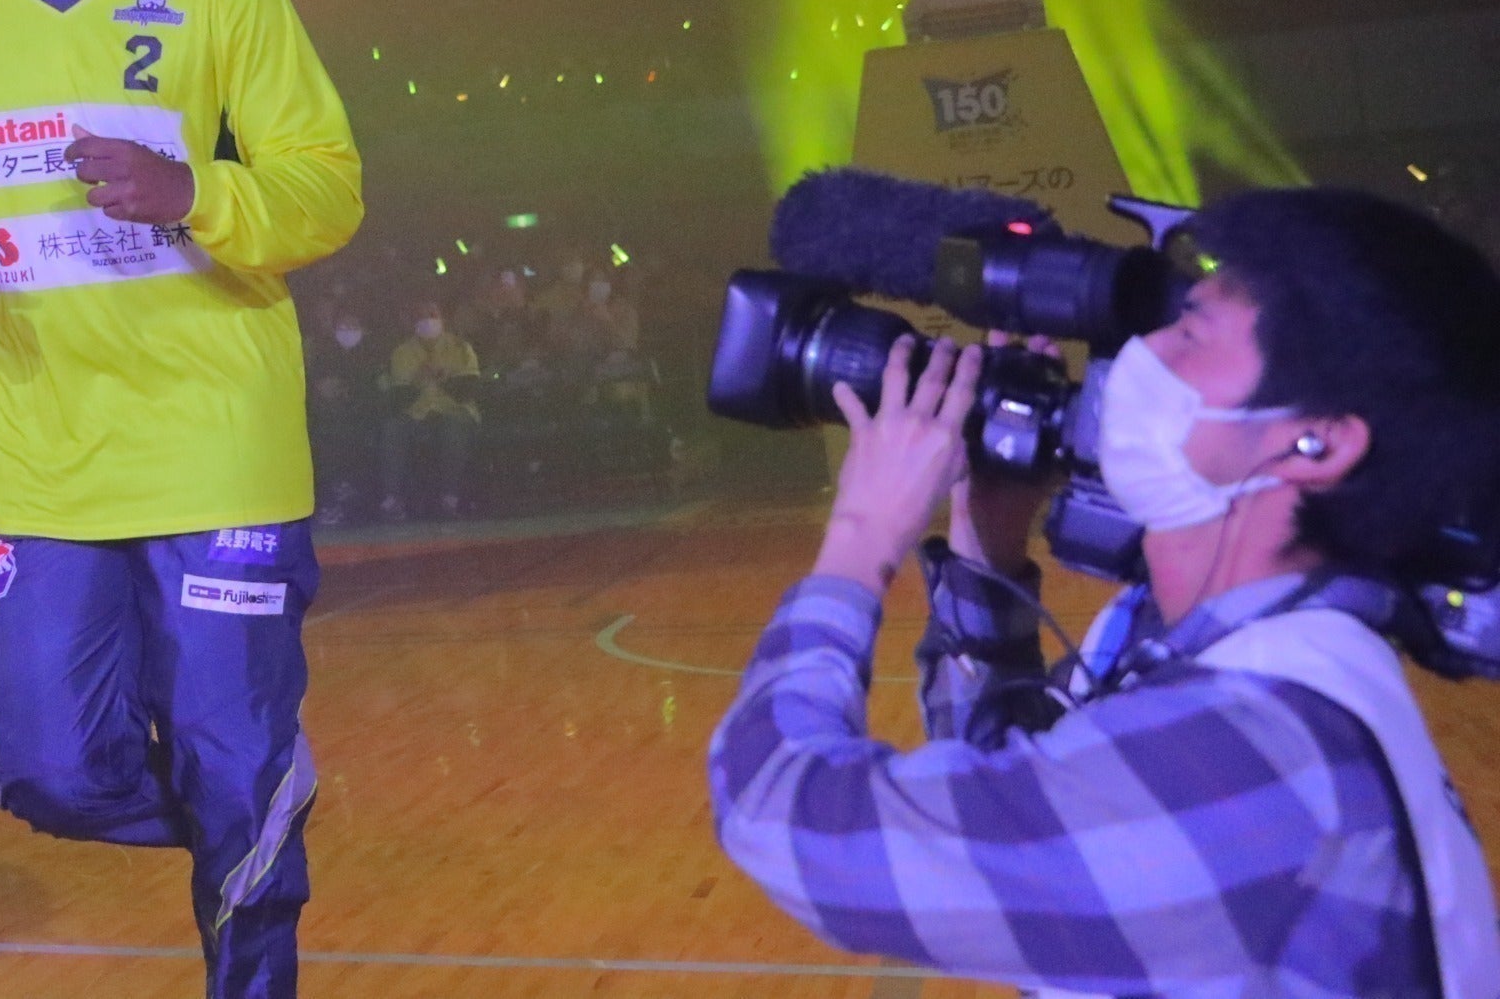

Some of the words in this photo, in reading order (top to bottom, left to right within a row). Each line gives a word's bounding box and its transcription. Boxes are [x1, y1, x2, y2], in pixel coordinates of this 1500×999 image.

[124, 34, 162, 93] 2
[936, 83, 1006, 123] 150
[38, 225, 143, 260] 株式会社
[149, 222, 194, 248] 鈴木
[92, 256, 122, 268] SUZUKI
[215, 529, 277, 553] 長野電子
